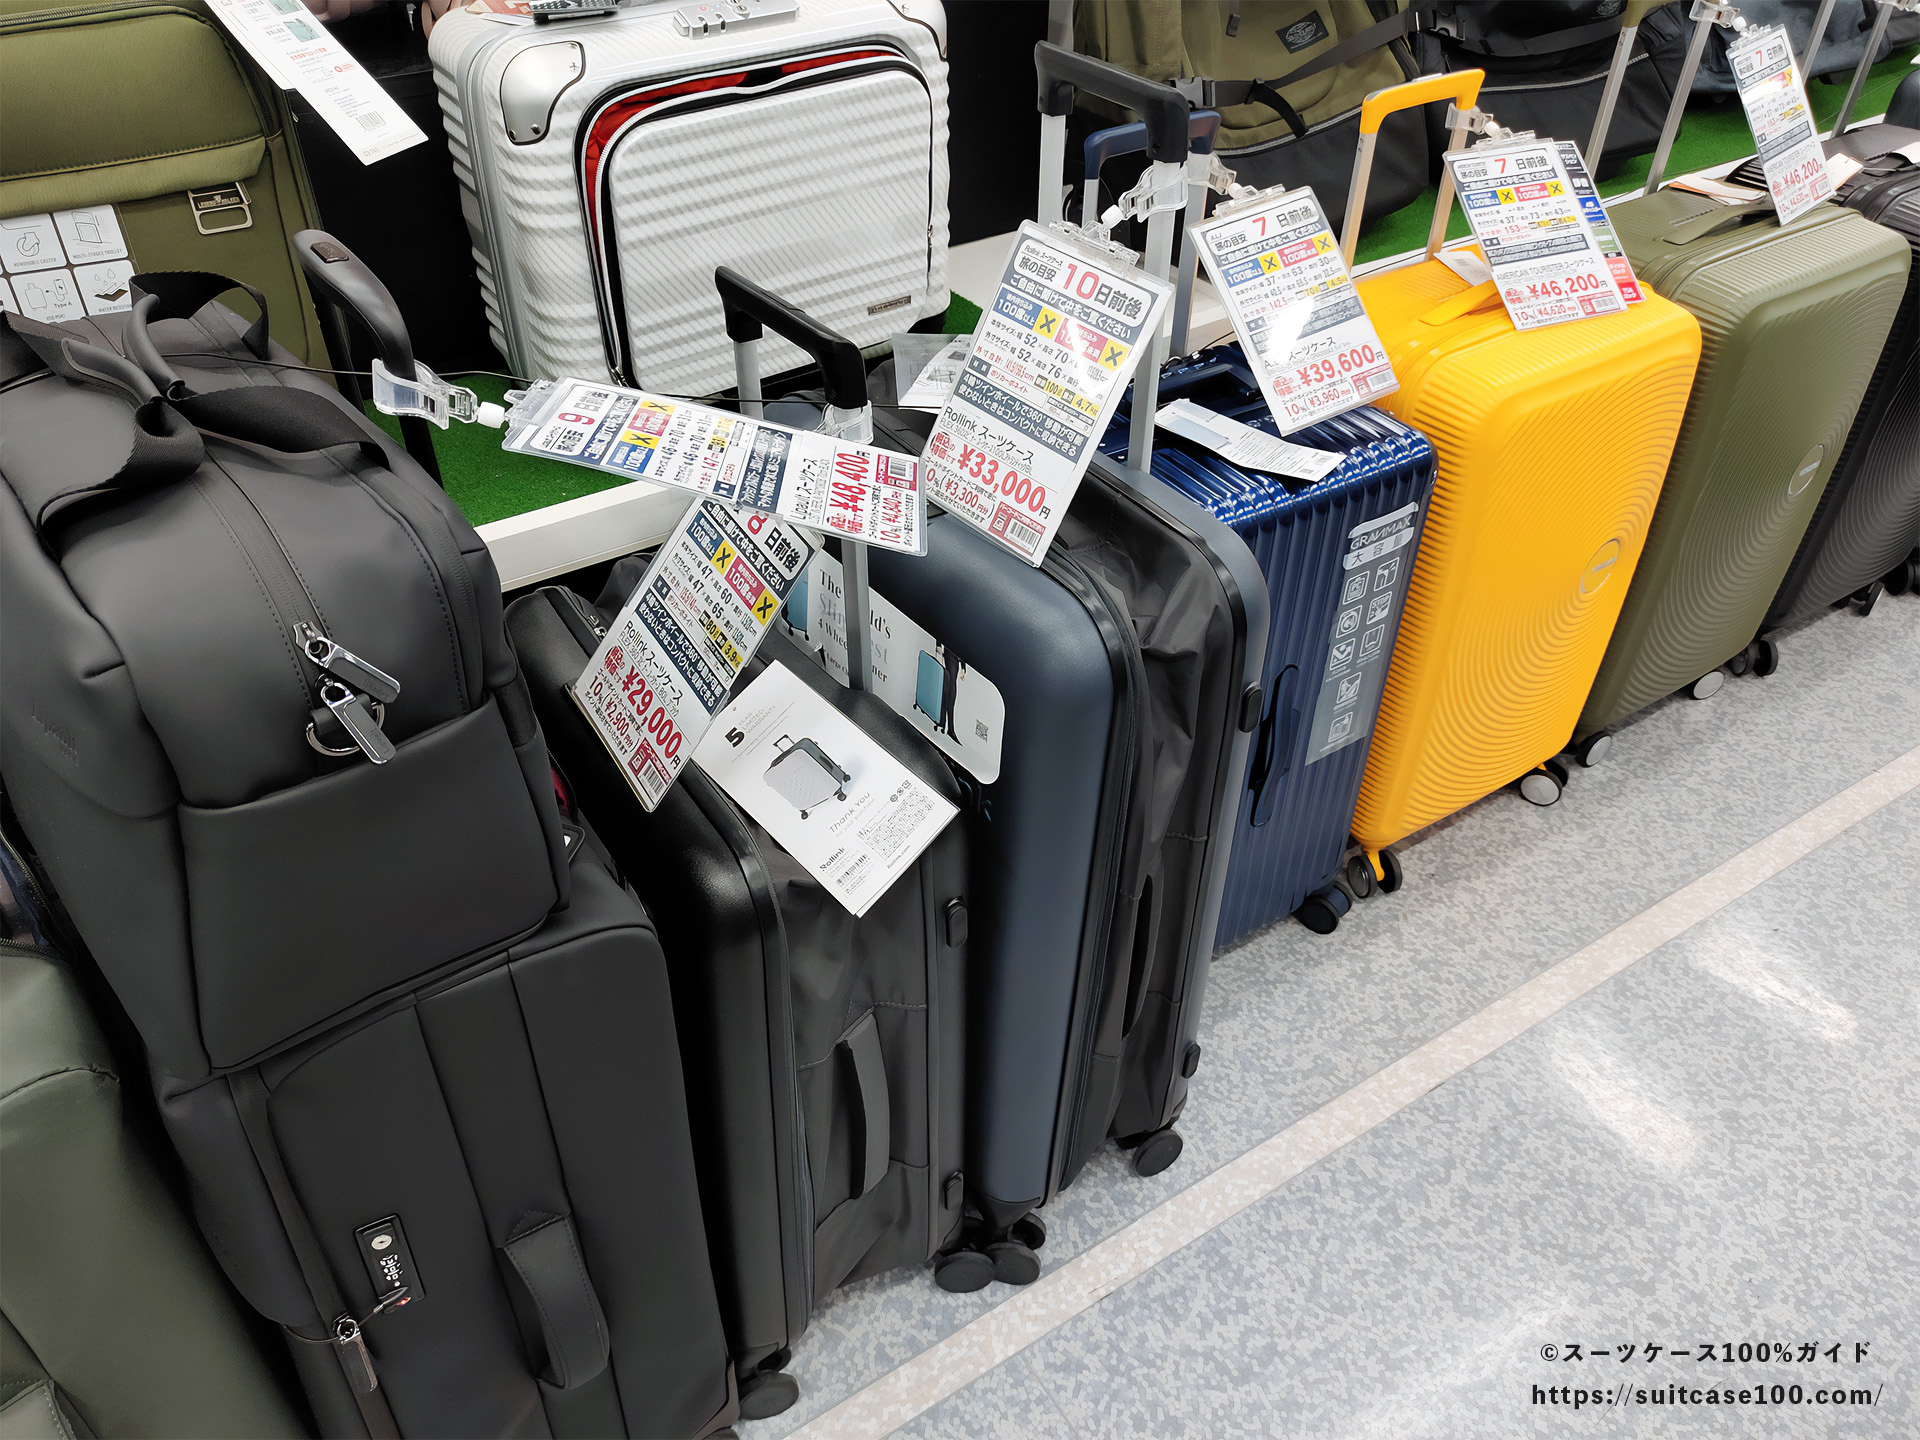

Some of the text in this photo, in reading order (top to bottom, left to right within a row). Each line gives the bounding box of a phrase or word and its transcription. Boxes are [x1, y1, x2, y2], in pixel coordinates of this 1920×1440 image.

[1493, 157, 1511, 174] 7
[1251, 215, 1272, 237] 7
[1504, 215, 1516, 223] 37
[1017, 254, 1058, 283] 旅の目安
[1264, 275, 1277, 286] 37
[1290, 265, 1304, 276] 63
[1494, 268, 1529, 281] AMERICAN
[1529, 262, 1565, 275] TOURISTER
[1015, 346, 1032, 363] 52
[1046, 363, 1063, 380] 76
[1022, 332, 1039, 349] 52
[1053, 348, 1070, 365] 70
[556, 410, 596, 427] 9
[942, 405, 1036, 467] Rollink スーツケース
[795, 456, 818, 495] スーツケース
[1350, 514, 1412, 550] GRANMAX
[762, 525, 803, 573] 日前後
[690, 576, 704, 595] 47
[710, 600, 724, 620] 65
[699, 563, 713, 581] 47
[719, 586, 733, 605] 60
[820, 569, 842, 599] The
[623, 619, 685, 707] Rollink スーツケース
[618, 663, 691, 769] ¥29,000円
[742, 709, 764, 730] LIMITED
[746, 706, 776, 734] WARRANTY
[725, 727, 745, 748] 5
[830, 792, 870, 833] Thank You
[820, 846, 846, 872] Rollink
